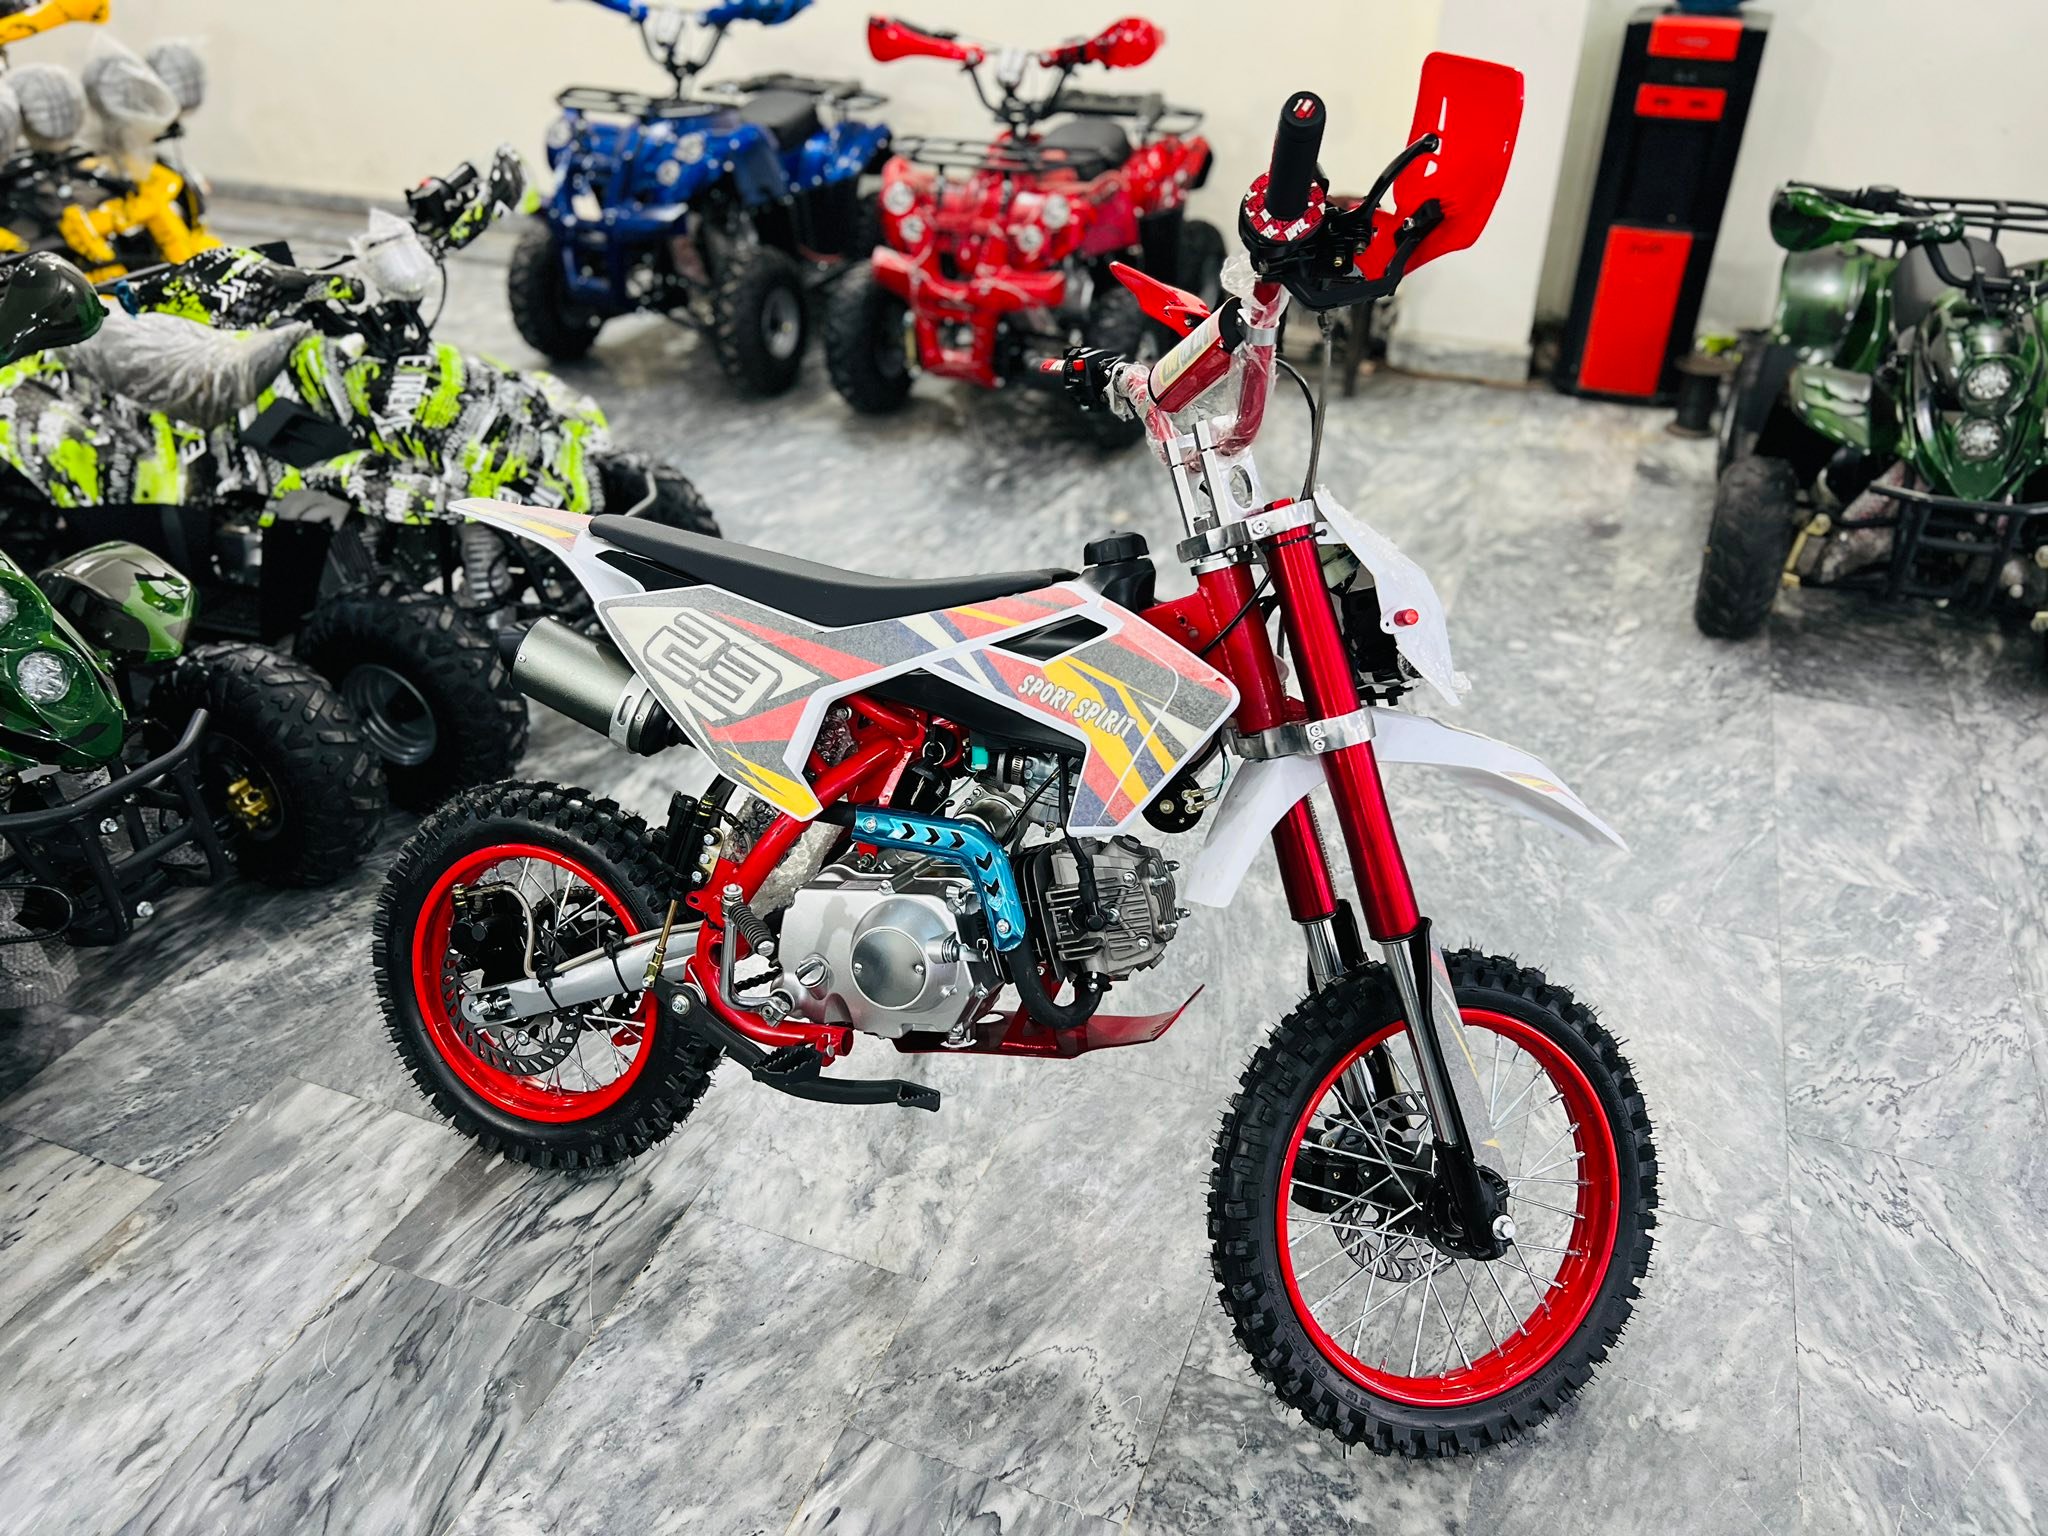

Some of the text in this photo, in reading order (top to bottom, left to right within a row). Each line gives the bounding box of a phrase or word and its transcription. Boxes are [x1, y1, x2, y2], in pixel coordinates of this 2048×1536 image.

[642, 611, 783, 716] 23
[1018, 674, 1137, 738] SPORT SPIRIT
